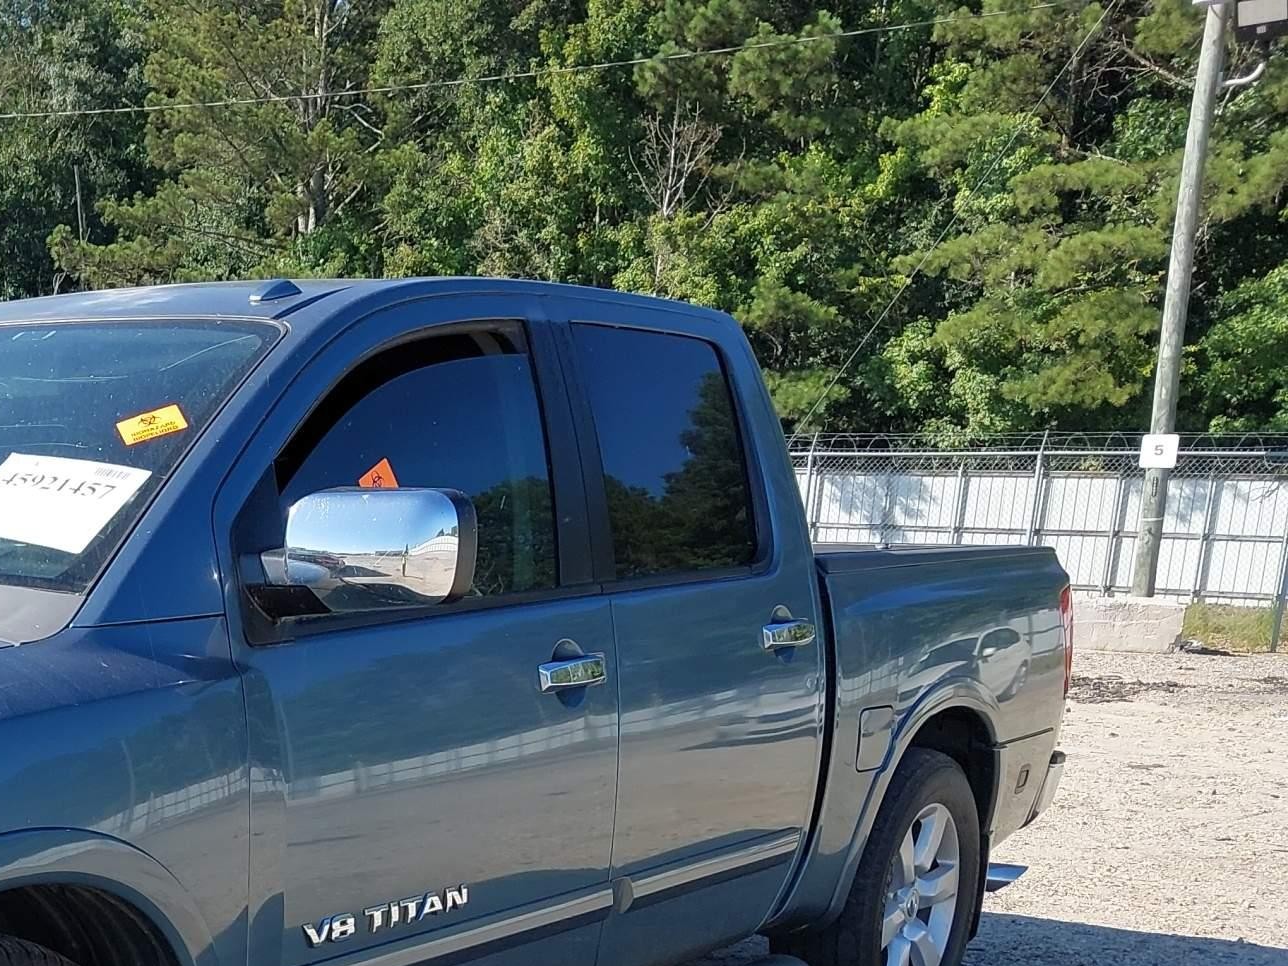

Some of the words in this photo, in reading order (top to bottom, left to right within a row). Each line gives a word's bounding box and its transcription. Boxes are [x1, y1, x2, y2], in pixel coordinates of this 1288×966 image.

[1154, 445, 1164, 456] 5
[2, 472, 117, 499] 45921457
[303, 913, 356, 947] V8
[363, 885, 469, 934] TITAN
